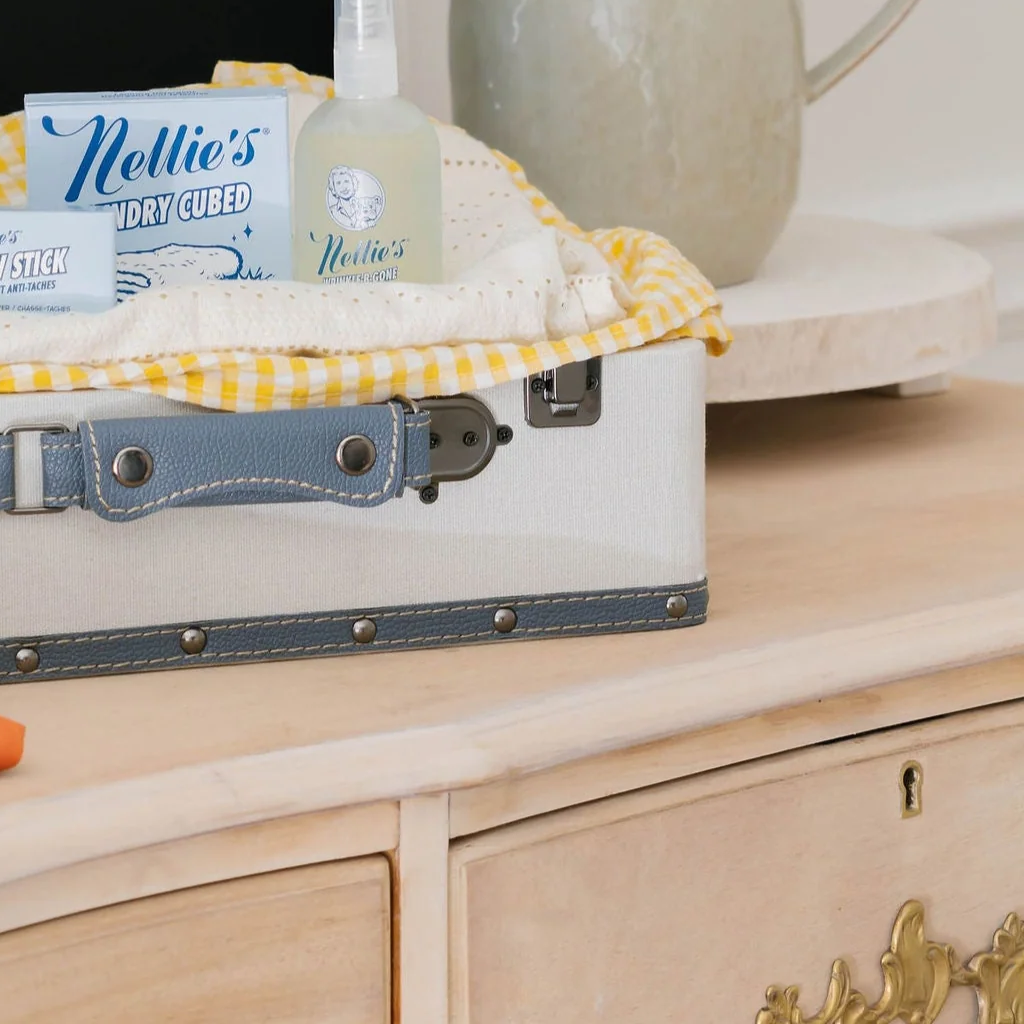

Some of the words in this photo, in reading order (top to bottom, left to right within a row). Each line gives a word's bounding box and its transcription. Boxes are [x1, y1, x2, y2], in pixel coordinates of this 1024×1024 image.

[91, 192, 175, 232] NDRY
[177, 181, 252, 222] CUBED
[9, 246, 70, 280] STICK
[309, 231, 408, 276] Nellie's
[6, 279, 57, 295] ANTI-TACHES
